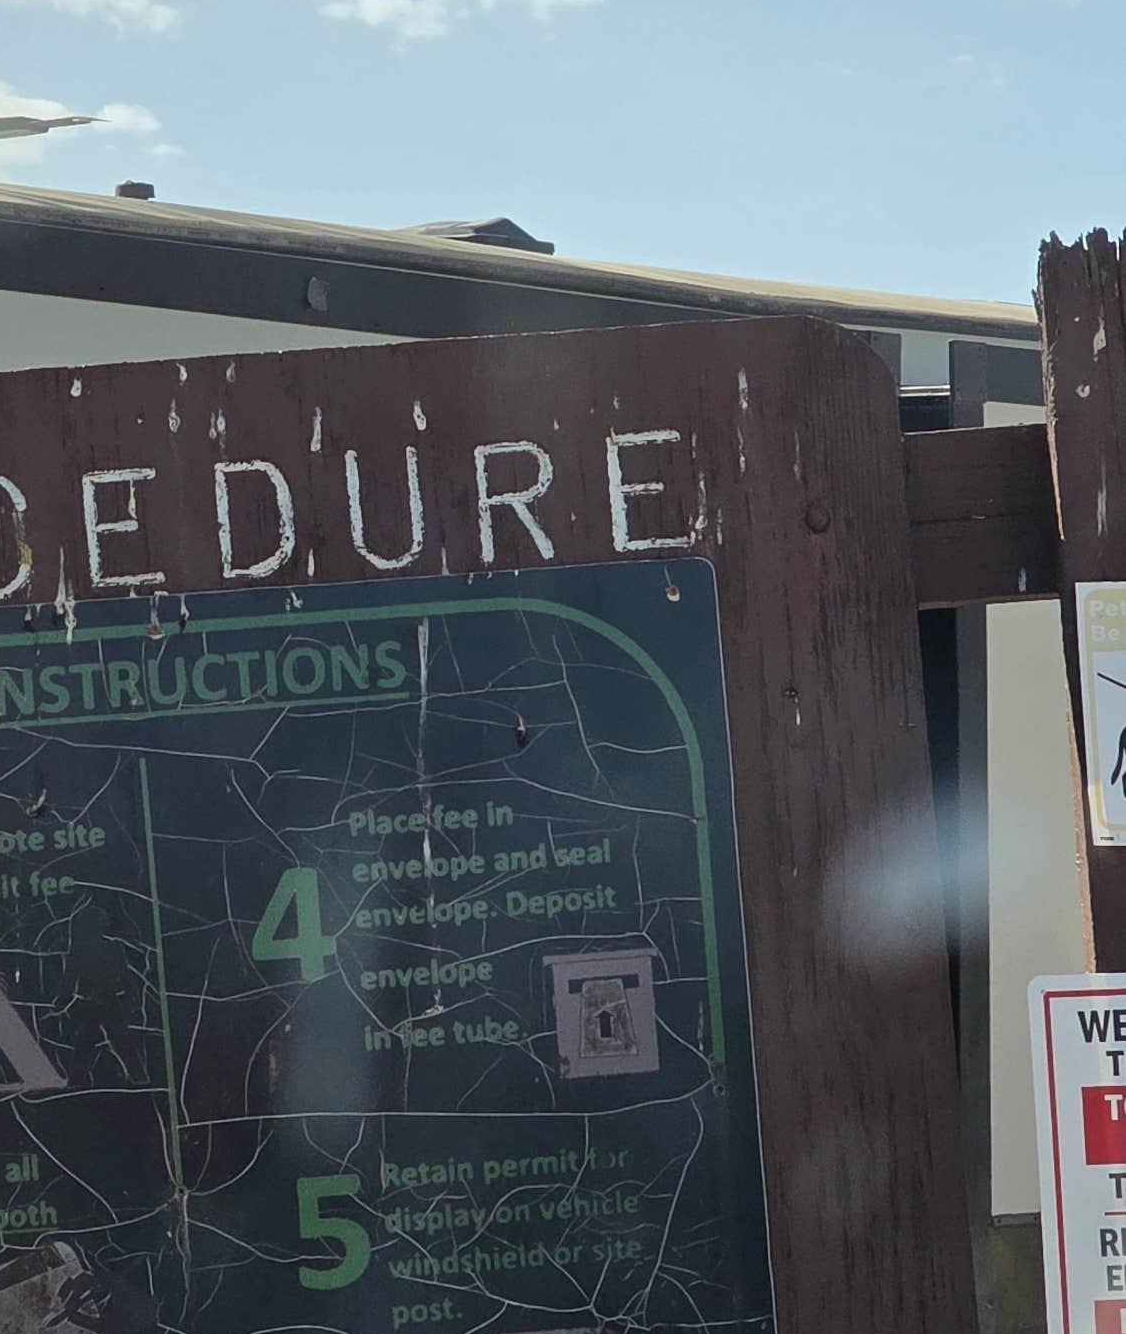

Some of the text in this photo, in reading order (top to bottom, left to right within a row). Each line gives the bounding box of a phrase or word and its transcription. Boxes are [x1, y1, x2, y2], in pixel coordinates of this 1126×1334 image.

[53, 823, 106, 850] site
[349, 802, 514, 836] Place fee in
[352, 839, 611, 885] envelope and seal
[29, 870, 75, 897] fee
[356, 885, 616, 929] envelope. Deposit
[252, 867, 336, 983] 4
[361, 959, 493, 991] envelope
[364, 1017, 528, 1052] in fee tube.
[5, 1154, 40, 1182] all
[382, 1162, 473, 1188] Retain
[483, 1152, 579, 1184] permit
[384, 1193, 639, 1234] display on vehicle
[296, 1174, 371, 1290] 5
[388, 1239, 643, 1278] windshield or site
[392, 1298, 463, 1330] post.
